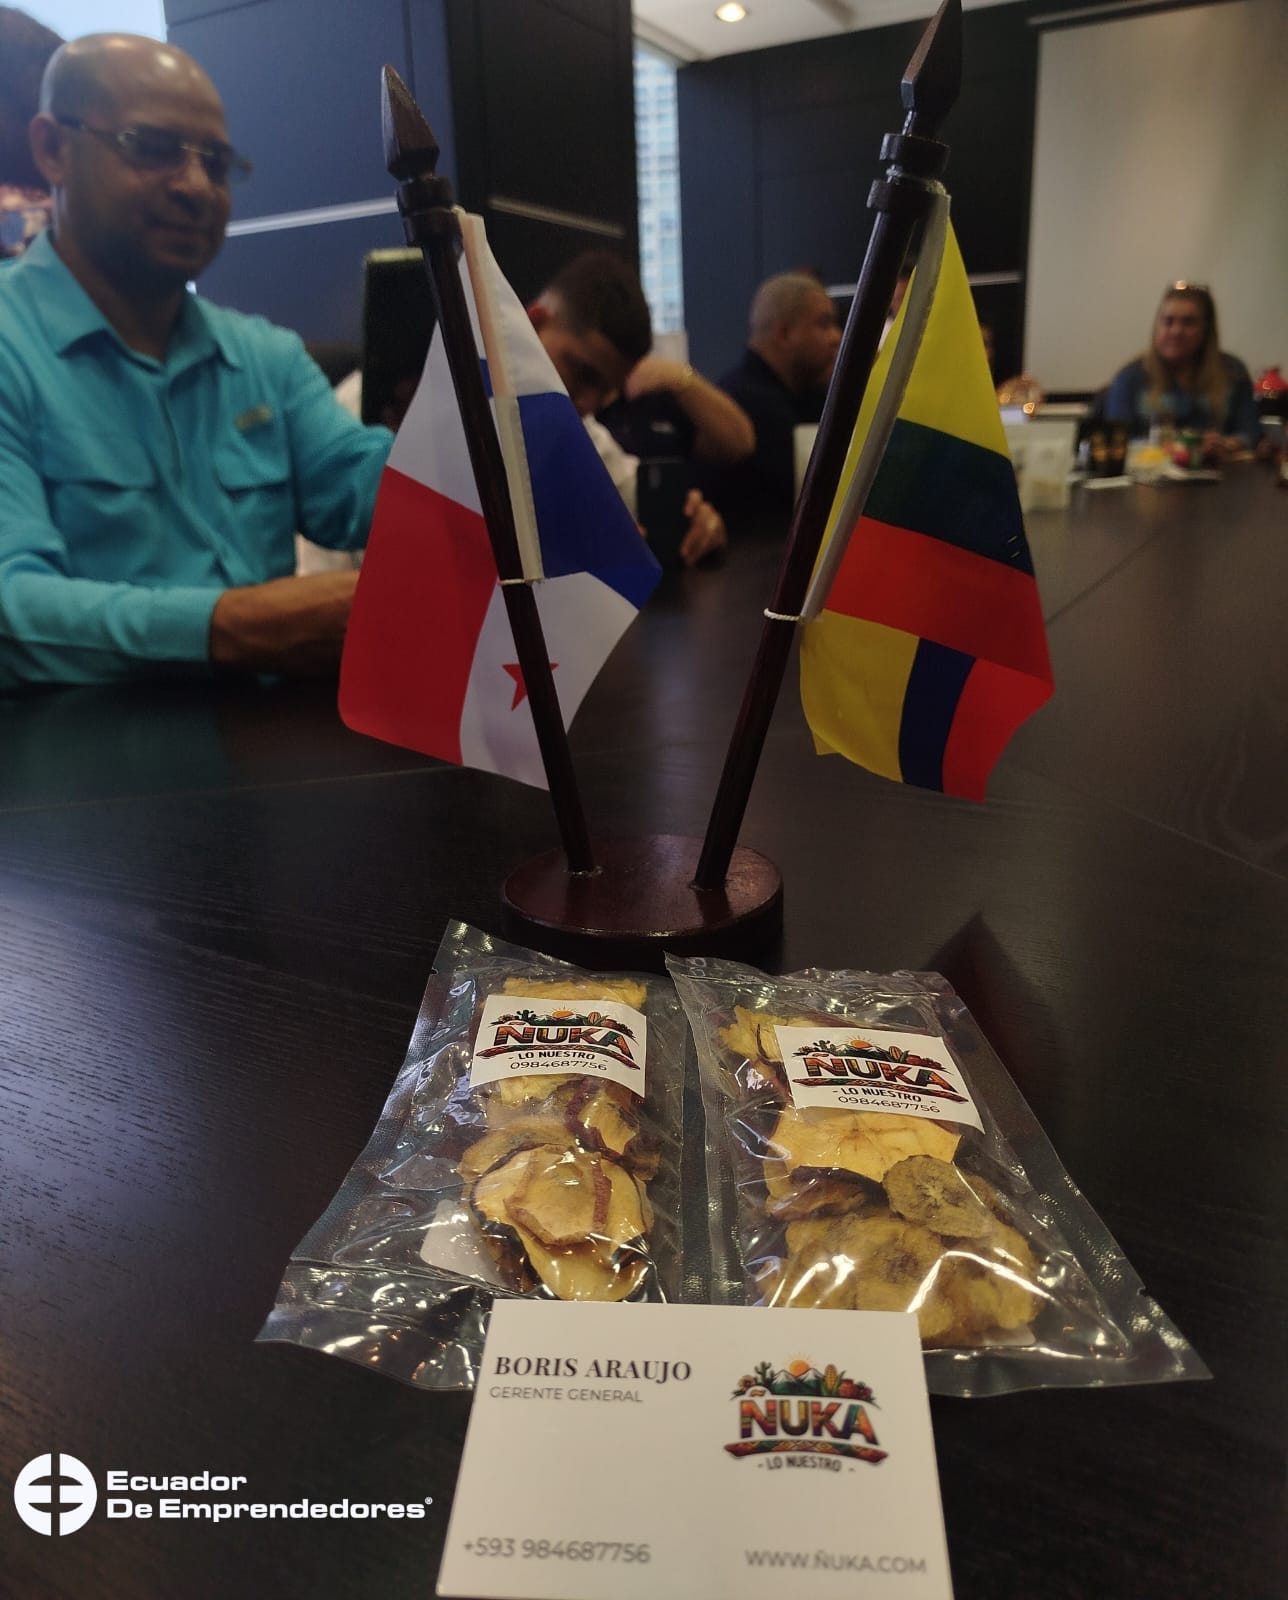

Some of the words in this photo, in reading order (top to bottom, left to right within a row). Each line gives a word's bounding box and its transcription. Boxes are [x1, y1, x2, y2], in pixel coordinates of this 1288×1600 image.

[518, 1051, 534, 1060] LO
[538, 1050, 595, 1060] NUESTRO
[510, 1060, 607, 1071] 0984687756
[842, 1087, 859, 1096] LO
[863, 1088, 922, 1103] NUESTRO
[838, 1095, 941, 1114] 0984687756
[494, 1357, 578, 1378] BORIS
[585, 1359, 692, 1384] ARAUJO
[490, 1386, 565, 1401] GERENTE
[568, 1388, 643, 1403] GENERAL
[740, 1390, 880, 1446] ÑUKA
[766, 1456, 783, 1471] LO
[786, 1456, 842, 1473] NUESTRO
[464, 1538, 516, 1557] +593
[521, 1540, 651, 1564] 984687756
[745, 1549, 927, 1574] WWW.ÑUKA.COM
